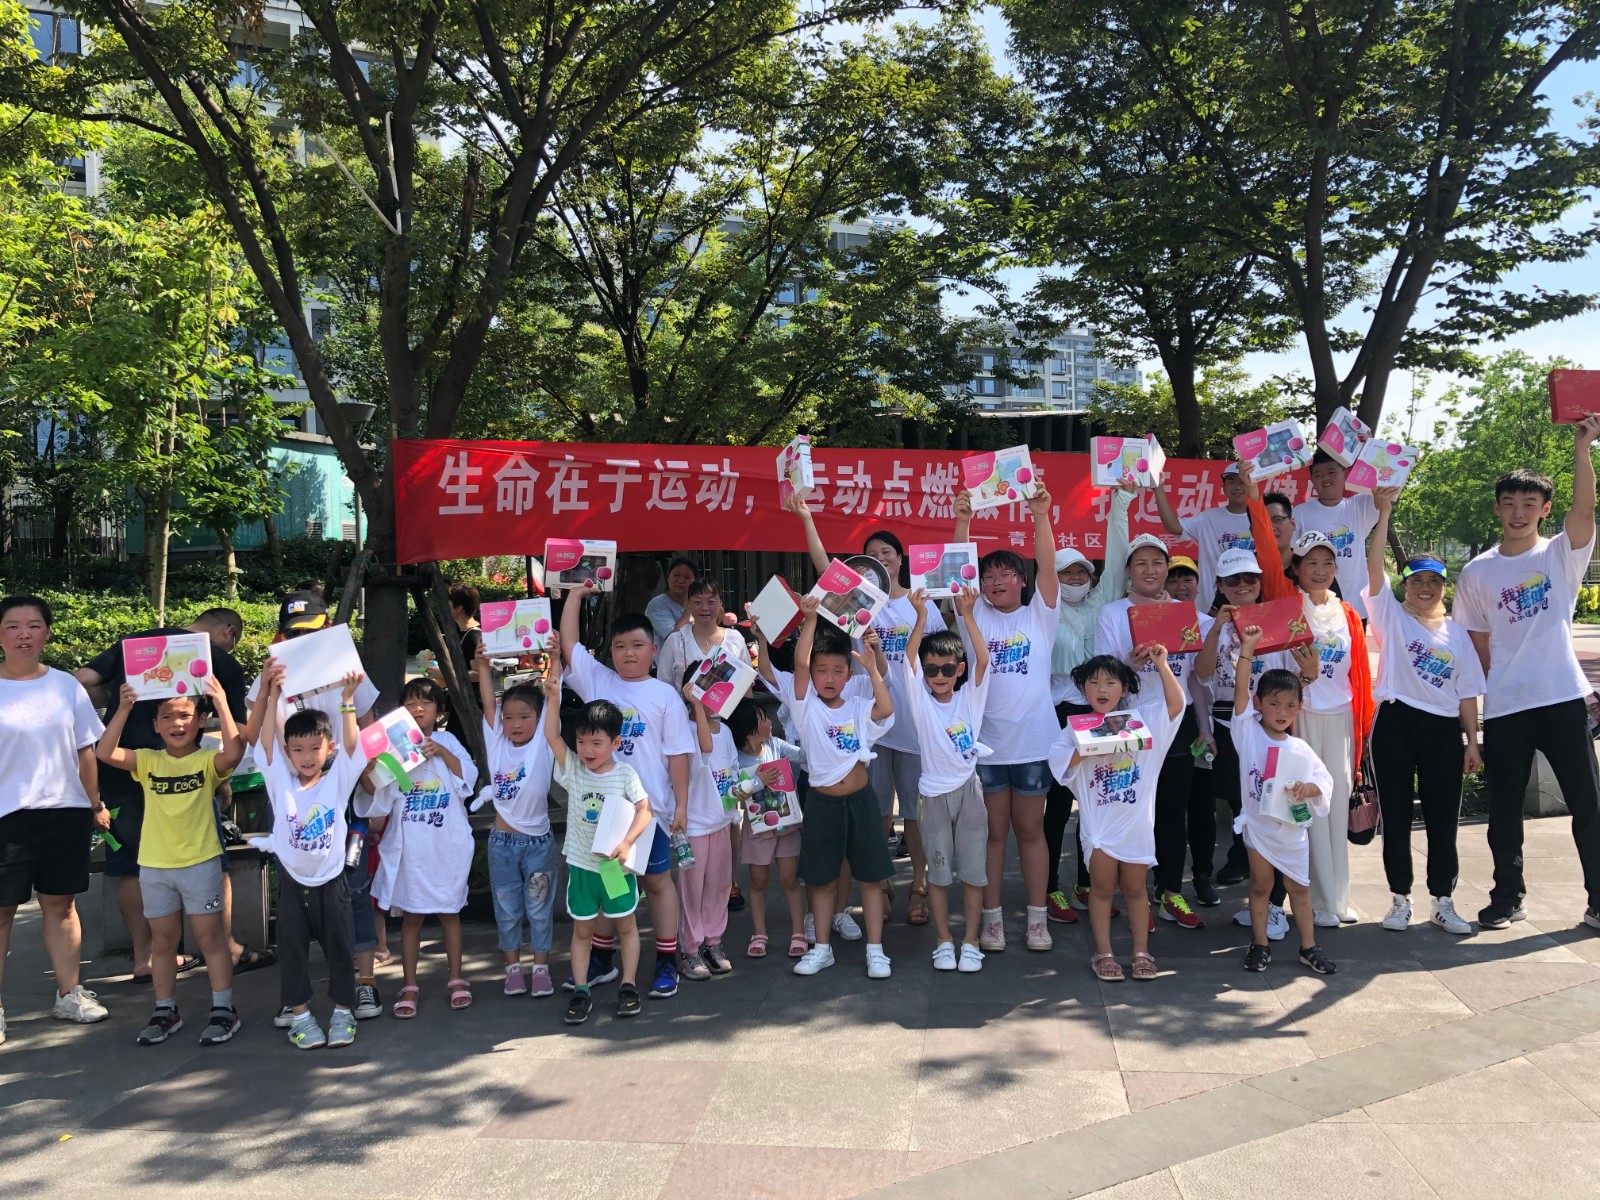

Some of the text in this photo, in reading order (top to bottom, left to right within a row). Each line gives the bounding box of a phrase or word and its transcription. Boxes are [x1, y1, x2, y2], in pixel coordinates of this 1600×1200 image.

[288, 600, 309, 614] CAT
[881, 637, 908, 652] 我健
[174, 777, 202, 792] COOL
[404, 793, 451, 814] 我健康
[402, 811, 444, 828] 乐健康跑
